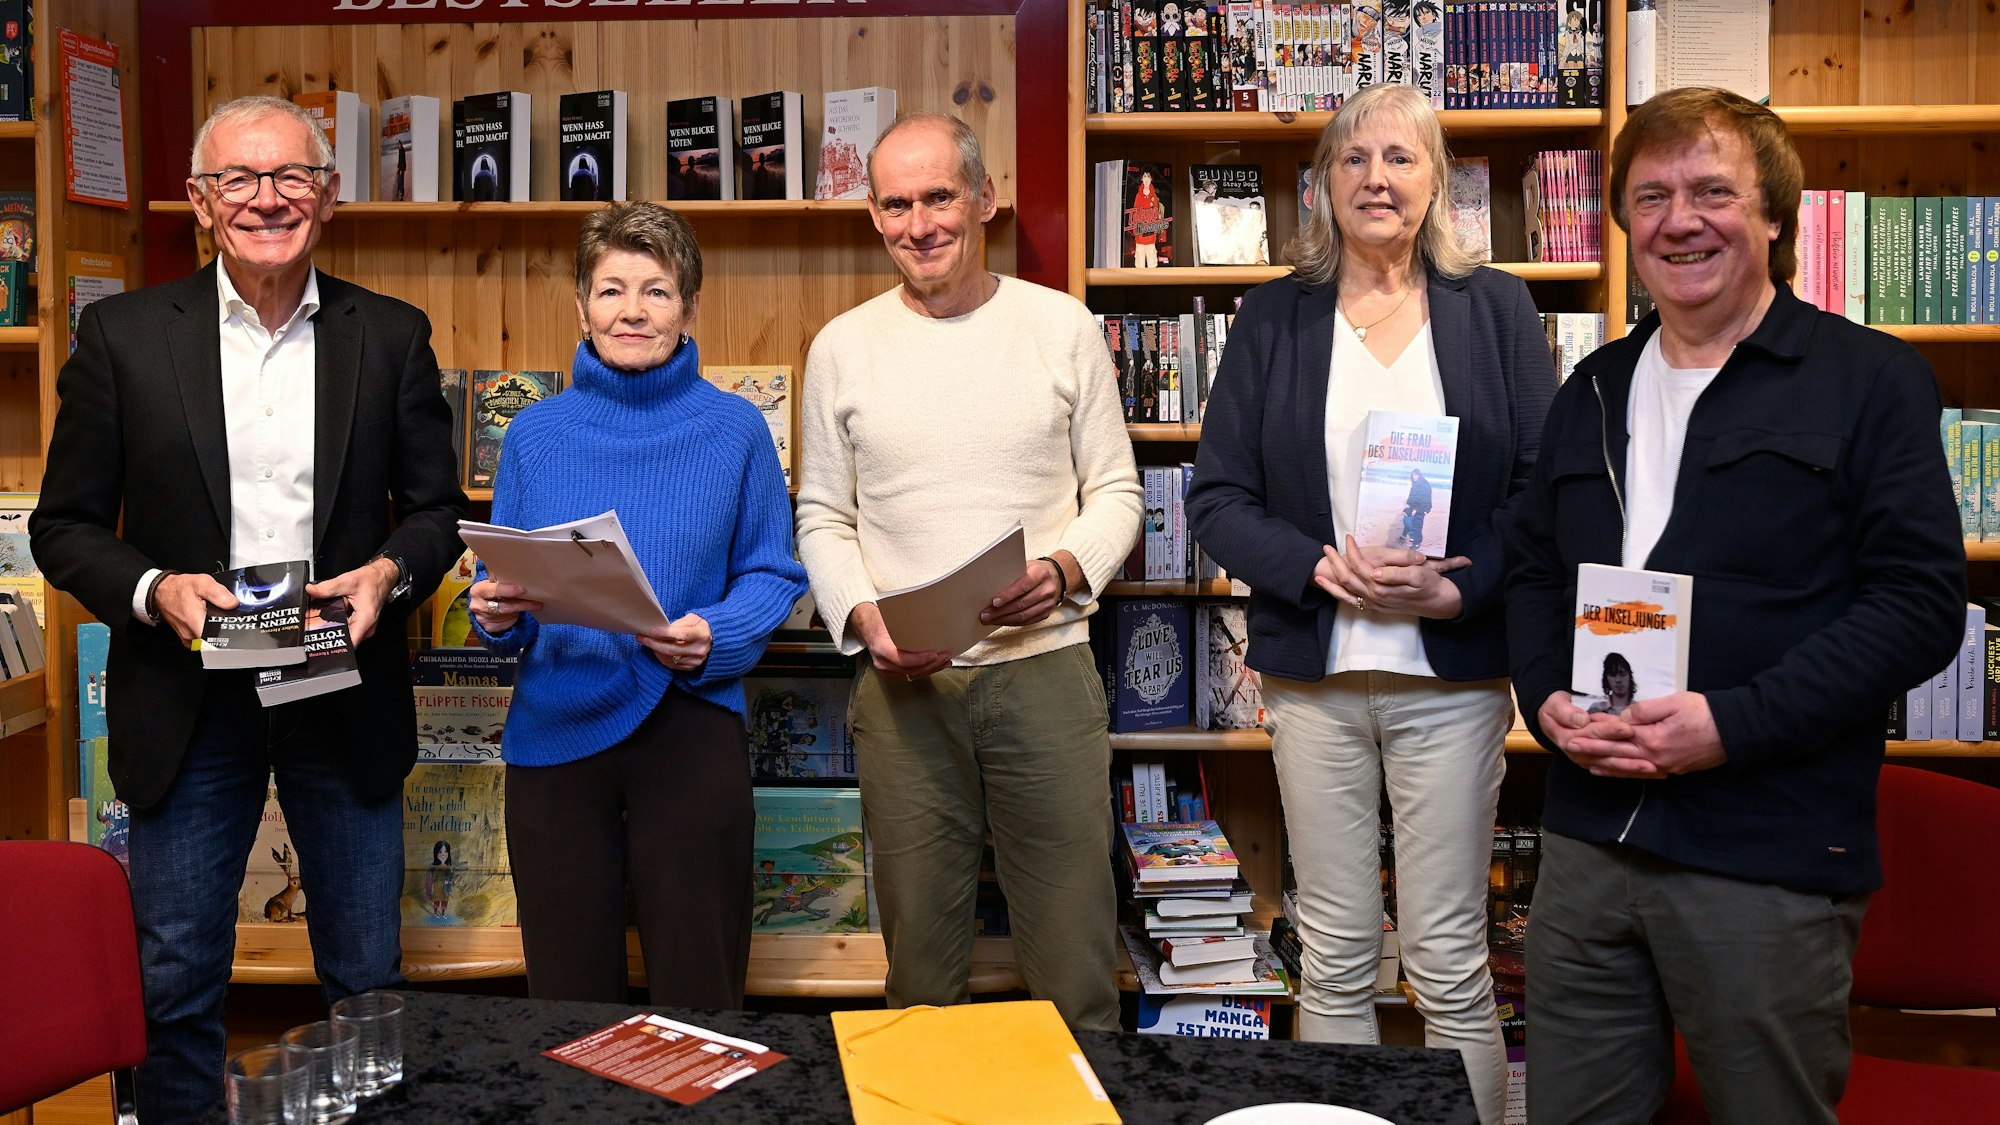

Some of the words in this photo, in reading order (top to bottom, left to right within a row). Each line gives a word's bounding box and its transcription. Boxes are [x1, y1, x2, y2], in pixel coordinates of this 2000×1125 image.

[1137, 42, 1151, 69] DRAGON
[1163, 41, 1176, 69] DRAGON
[1189, 41, 1202, 68] DRAGON
[829, 116, 860, 124] AKKORDEON
[466, 125, 485, 134] WENN
[486, 122, 503, 131] HASS
[563, 124, 583, 133] WENN
[584, 121, 604, 131] HASS
[670, 129, 690, 137] WENN
[691, 125, 715, 135] BLICKE
[744, 126, 761, 135] WENN
[761, 122, 782, 132] BLICKE
[837, 124, 861, 133] SCHWIEG
[466, 135, 485, 145] BLIND
[486, 132, 510, 143] MACHT
[563, 133, 584, 143] BLIND
[585, 131, 612, 141] MACHT
[670, 137, 693, 148] TÖTEN
[744, 135, 763, 146] TÖTEN
[1199, 170, 1258, 182] BUNGO
[1566, 332, 1574, 352] FRUITS
[1584, 333, 1593, 354] FRUITS
[1391, 432, 1404, 446] DIE
[1408, 433, 1432, 448] FRAU
[1368, 445, 1385, 459] DES
[1388, 446, 1451, 465] INSELJUNGEN
[1966, 491, 1976, 526] HOOVER
[1987, 491, 1997, 525] HOOVER
[209, 615, 259, 623] MACHT
[261, 607, 300, 620] BLIND
[1583, 604, 1601, 622] DER
[1604, 607, 1667, 630] INSELJUNGE
[260, 616, 300, 629] WENN
[1137, 627, 1170, 651] LOVE
[305, 640, 347, 652] WENN
[469, 656, 489, 664] NGOZI
[1145, 651, 1163, 661] WILL
[260, 675, 282, 684] Krimi
[444, 672, 499, 687] Mamas
[1126, 664, 1161, 689] TEAR
[1166, 657, 1183, 676] US
[1143, 684, 1166, 695] APART
[1212, 688, 1263, 706] WINT
[411, 783, 422, 794] In
[423, 785, 455, 795] unserer
[103, 801, 129, 820] MEE
[406, 796, 436, 813] Nähe
[439, 801, 467, 813] wohnt
[419, 816, 477, 833] Mädchen
[778, 815, 841, 823] Leuchtturm
[791, 824, 845, 833] Erdbeereis
[1493, 841, 1510, 849] EXIT
[1222, 996, 1265, 1012] DEIN
[1205, 1010, 1264, 1028] MANGA
[1176, 1022, 1206, 1036] IST
[1210, 1026, 1264, 1040] NICHT
[1513, 1031, 1525, 1040] 18
[1512, 1070, 1526, 1078] Eur
